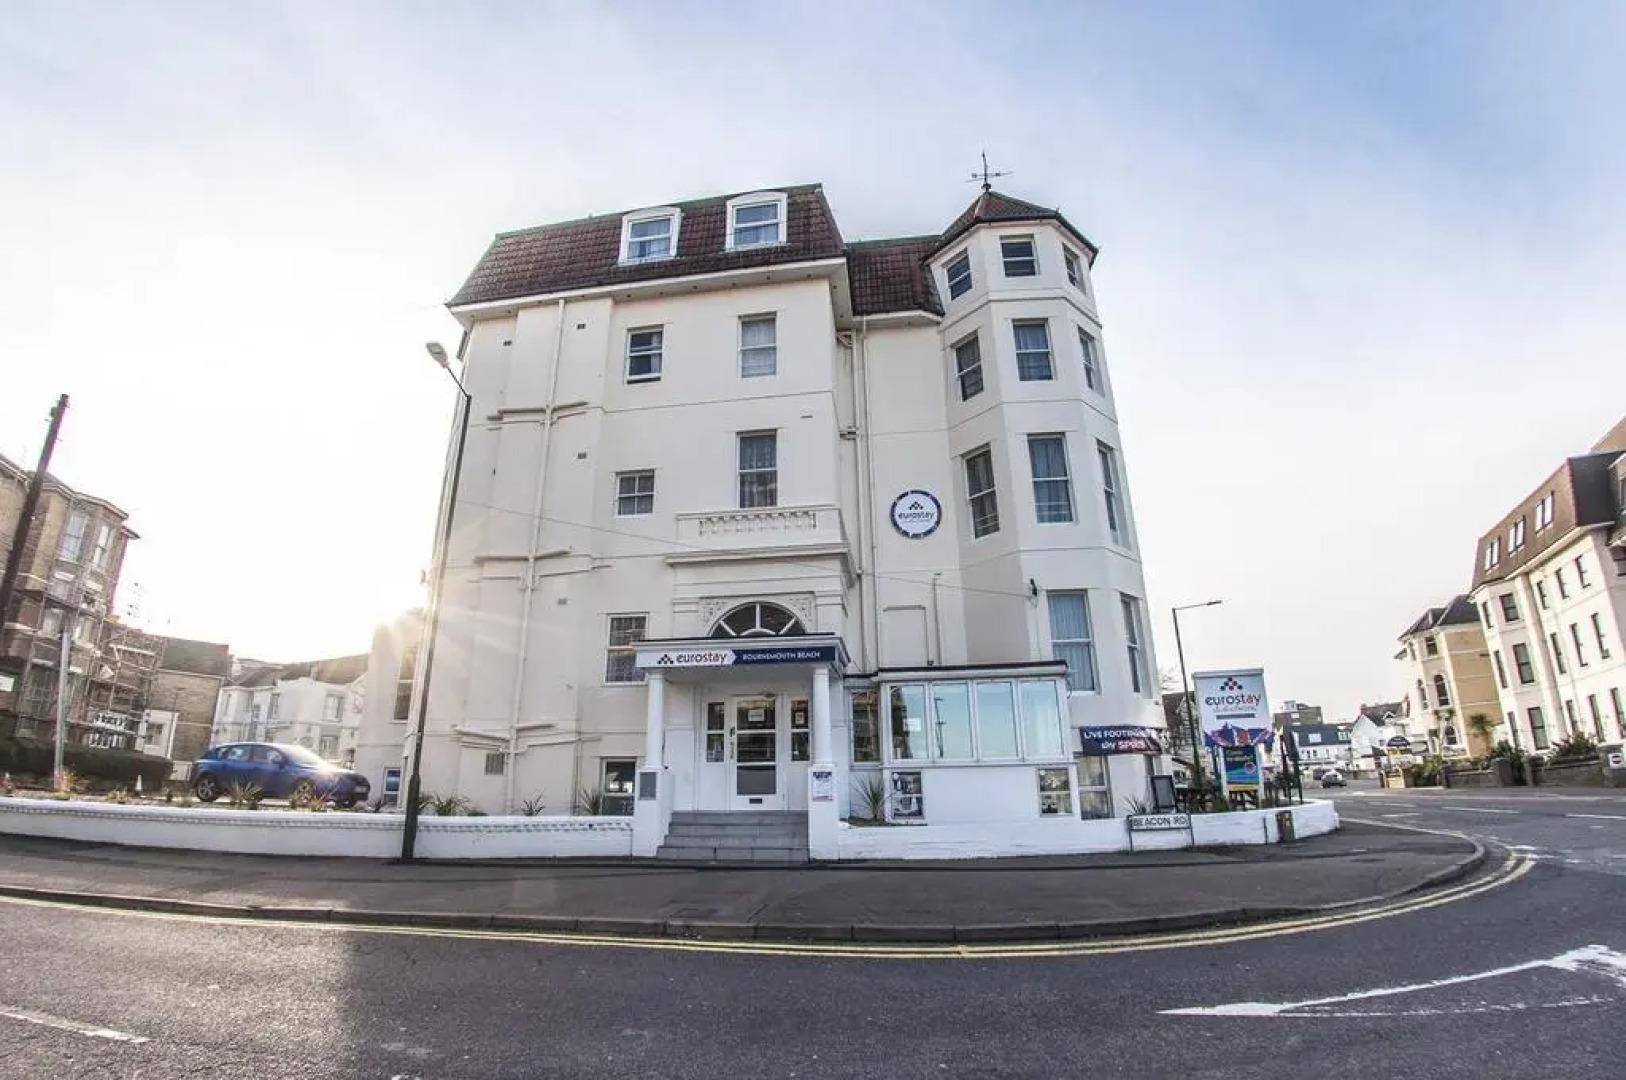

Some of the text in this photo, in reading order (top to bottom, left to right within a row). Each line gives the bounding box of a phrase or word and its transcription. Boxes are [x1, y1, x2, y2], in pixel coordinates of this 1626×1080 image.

[898, 512, 933, 520] eurostay
[676, 651, 821, 665] eurostay BOURNEMOUTH BEACH
[1205, 693, 1261, 707] eurostay
[1133, 817, 1171, 827] BEACON
